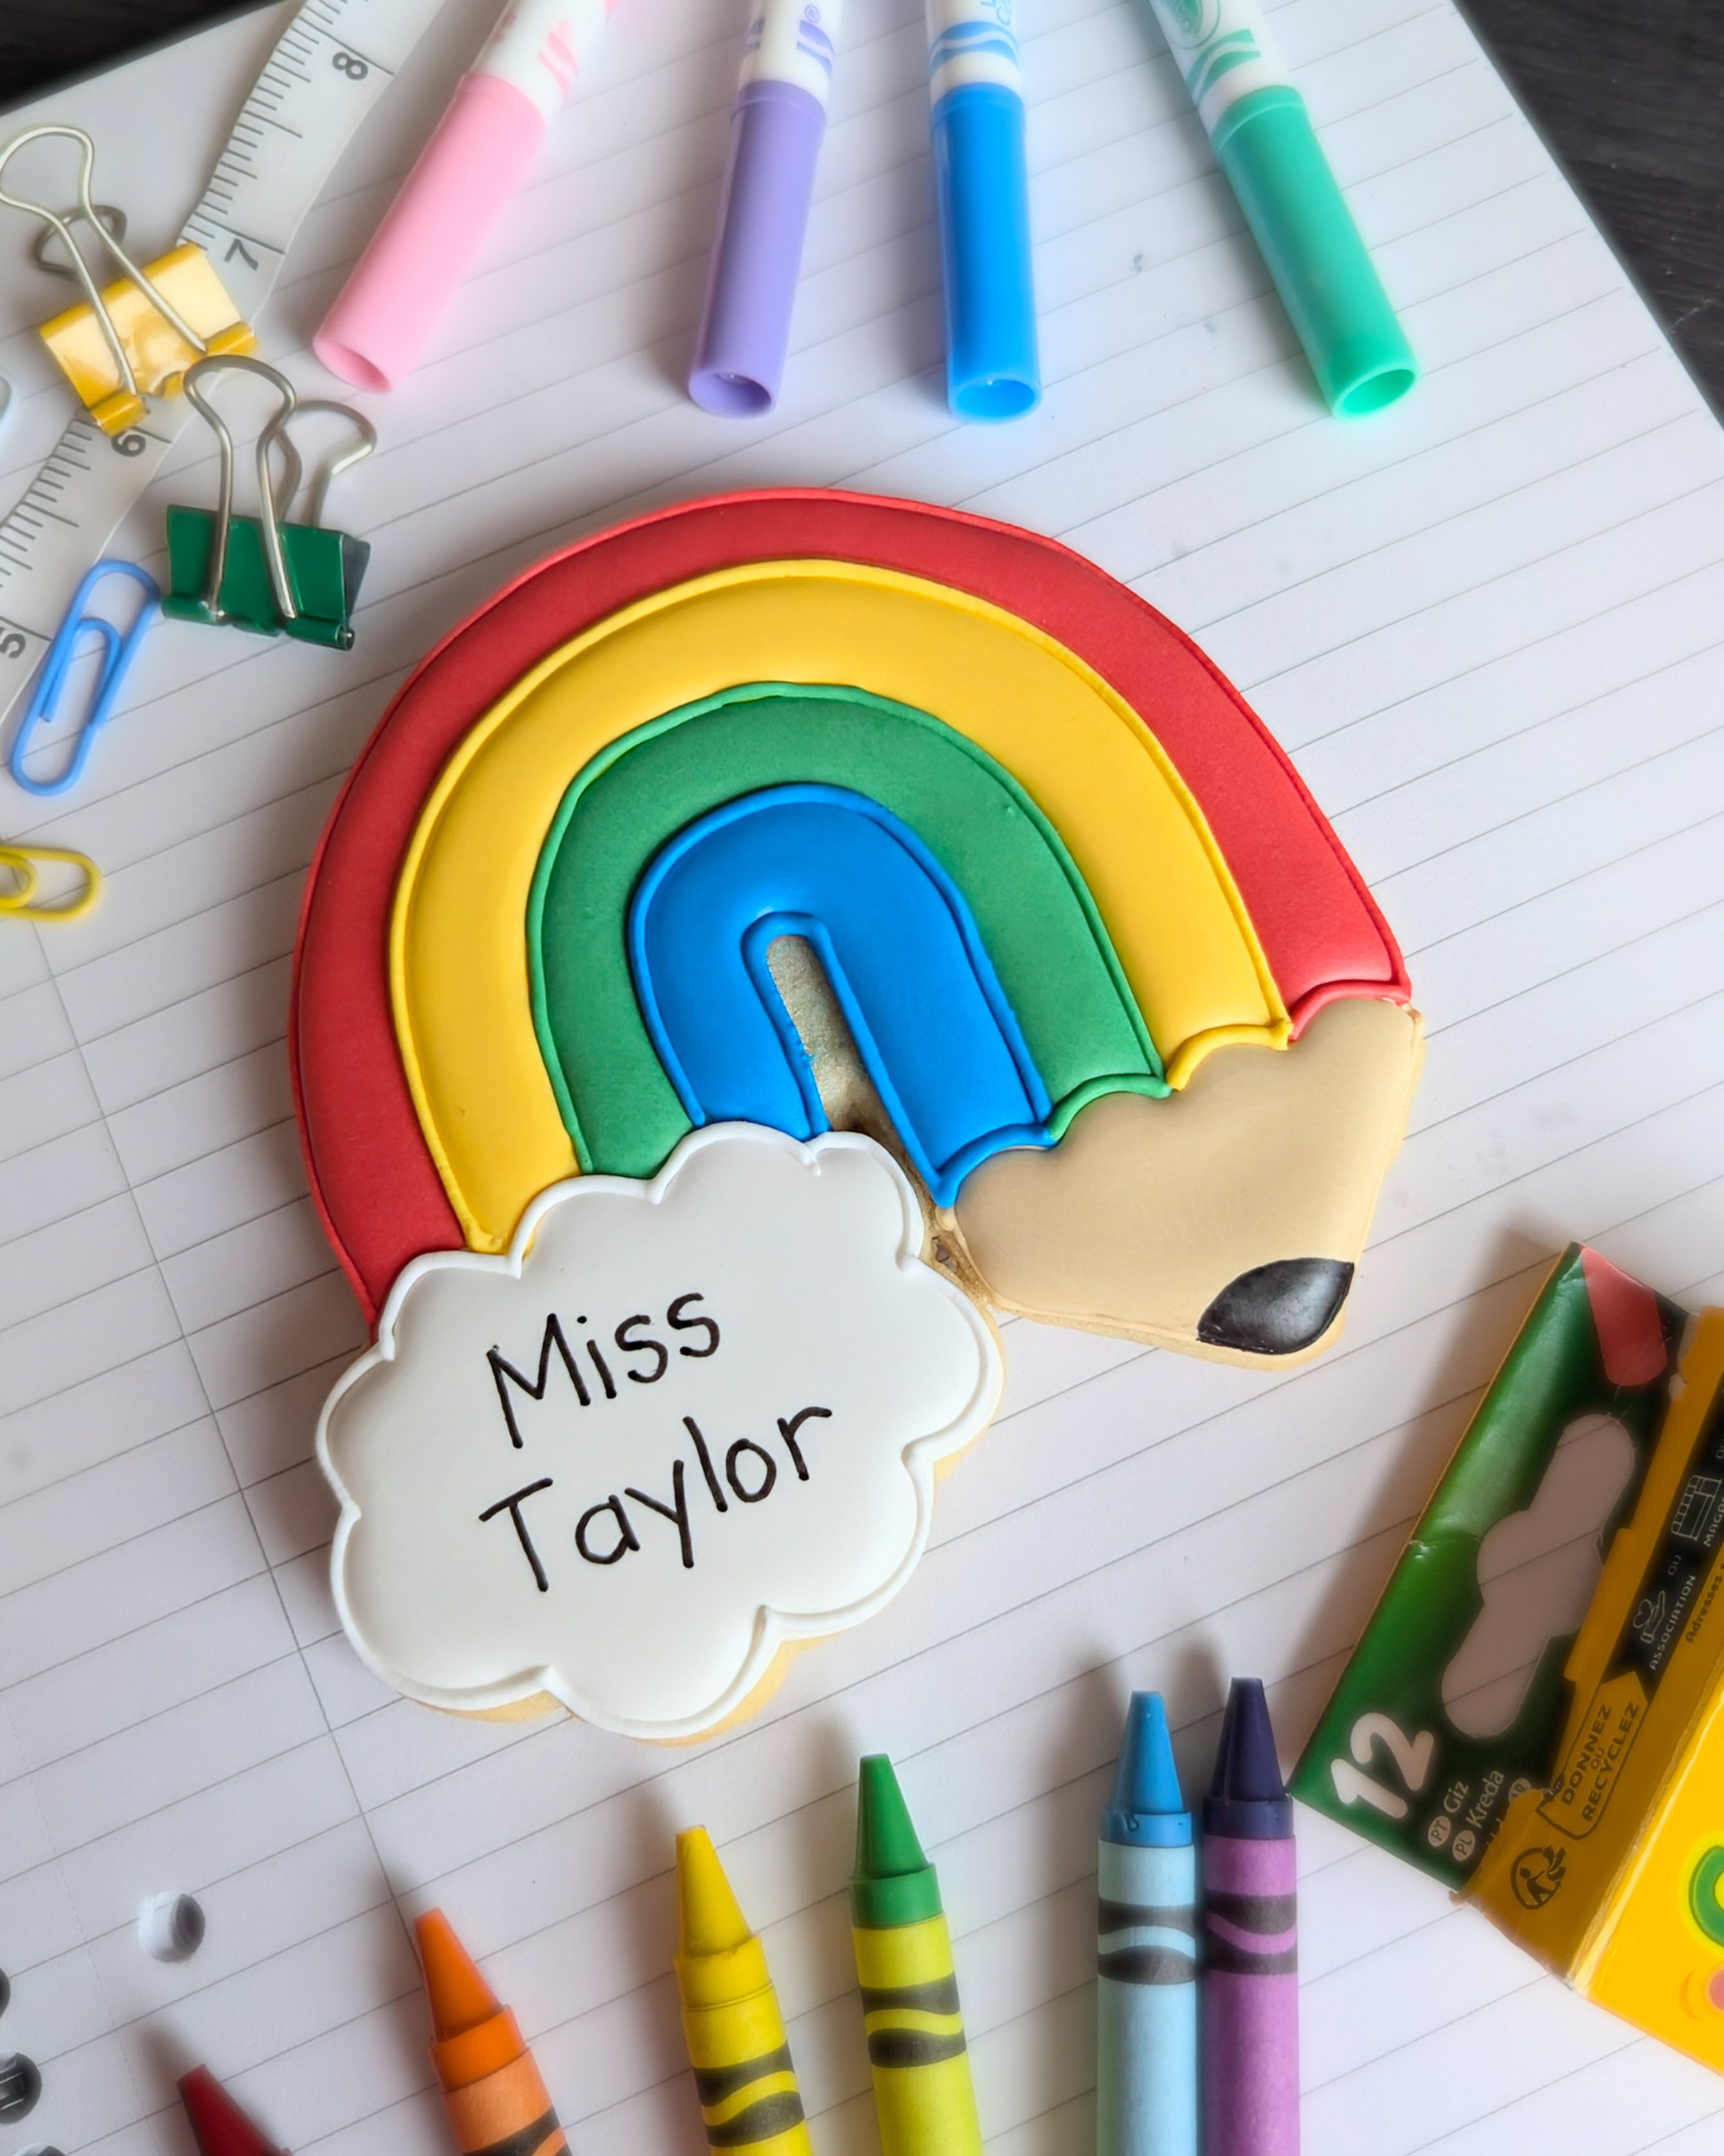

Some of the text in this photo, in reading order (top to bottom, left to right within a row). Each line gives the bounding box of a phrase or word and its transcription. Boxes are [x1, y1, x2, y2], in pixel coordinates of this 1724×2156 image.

[332, 51, 369, 81] 8
[223, 238, 259, 271] 7
[111, 429, 146, 458] 6
[0, 626, 26, 659] 5
[486, 1292, 720, 1449] Miss
[478, 1406, 832, 1592] Taylor
[1667, 1555, 1682, 1575] OU
[1649, 1575, 1696, 1670] ASSOCIATION
[1685, 1575, 1723, 1642] Adresses
[1331, 1712, 1434, 1818] 12
[1561, 1704, 1611, 1805] DONNEZ
[1581, 1702, 1639, 1821] RECYCLEZ
[1589, 1747, 1605, 1769] OU
[1430, 1780, 1469, 1842] PT Giz
[1465, 1770, 1504, 1828] Kreda
